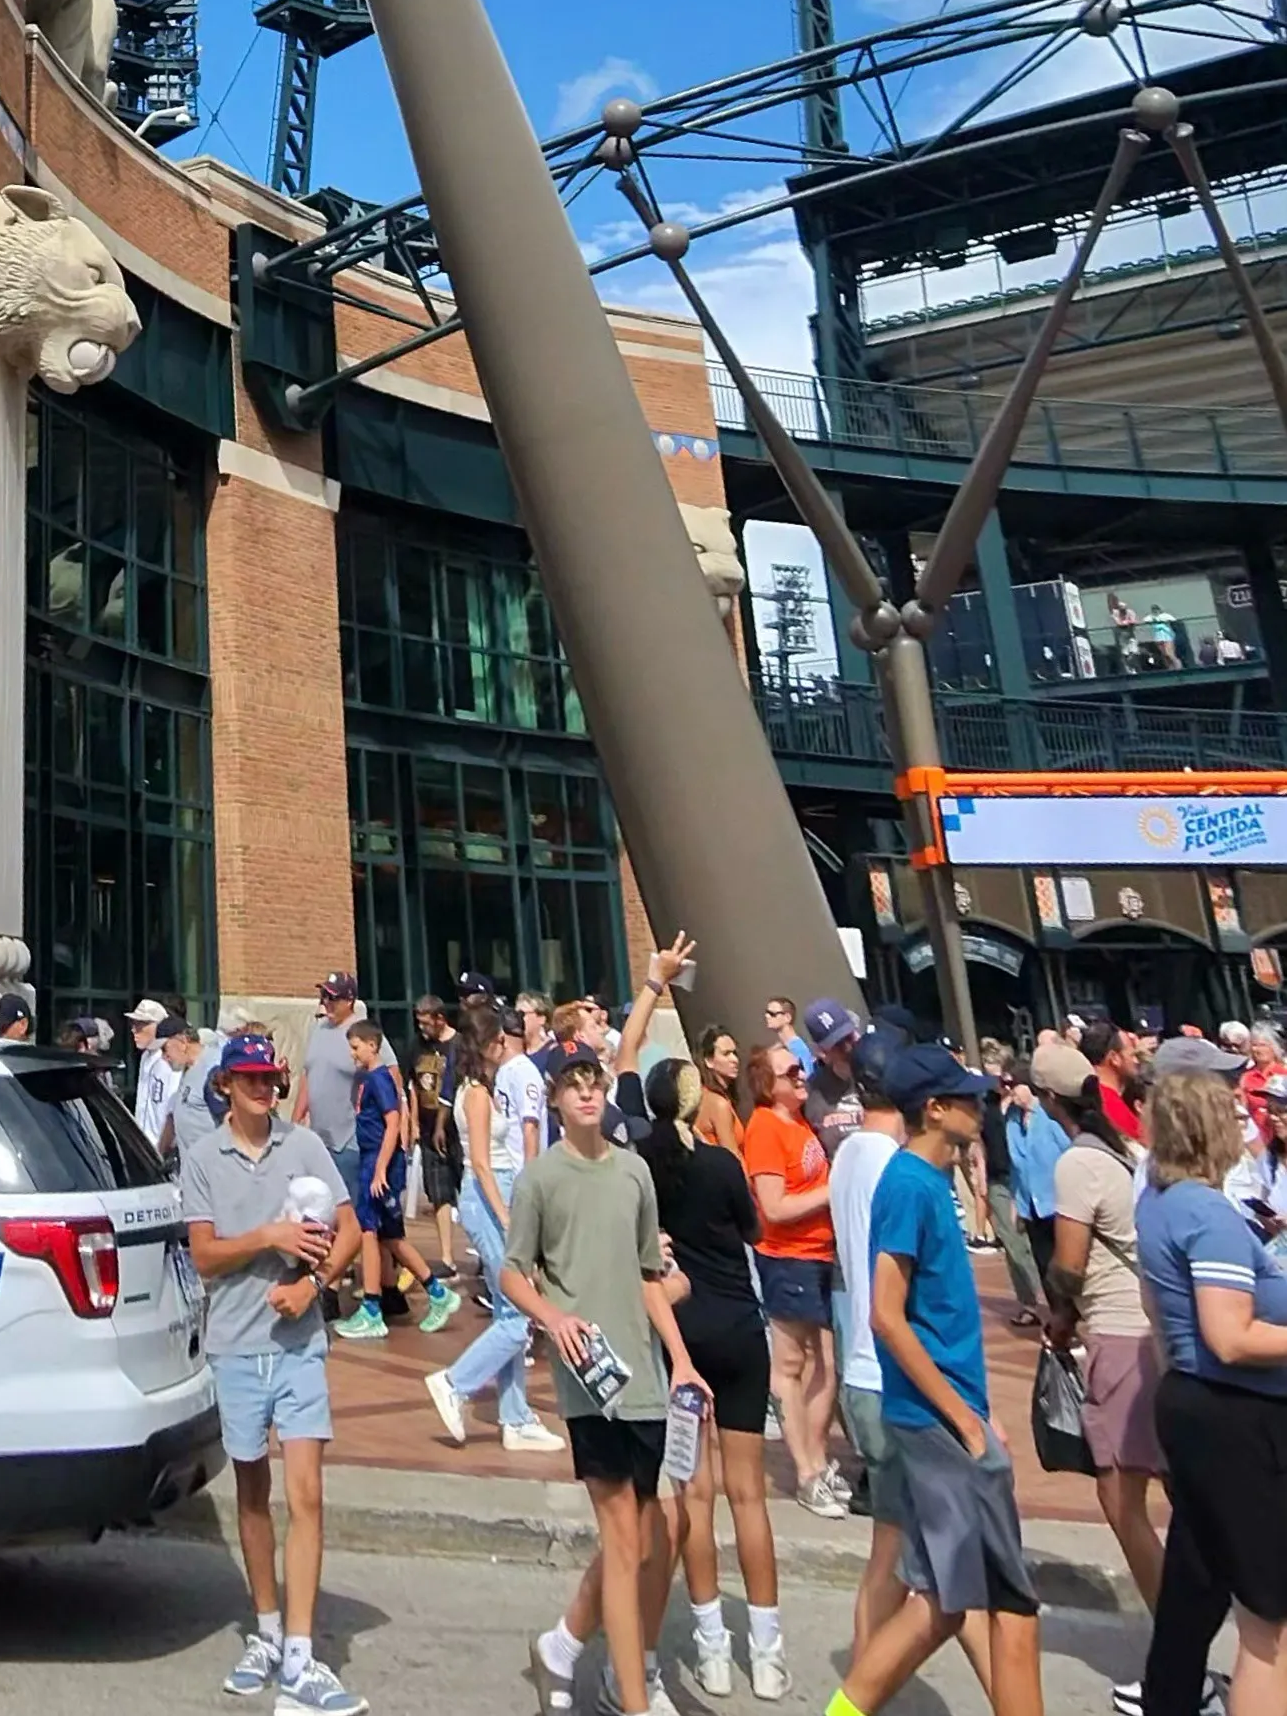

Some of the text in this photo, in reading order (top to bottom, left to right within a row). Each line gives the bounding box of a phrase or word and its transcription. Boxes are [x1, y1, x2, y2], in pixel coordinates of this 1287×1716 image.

[1184, 803, 1265, 833] CENTRAL
[1182, 817, 1262, 853] FLORIDA
[124, 1206, 177, 1224] DETRO
